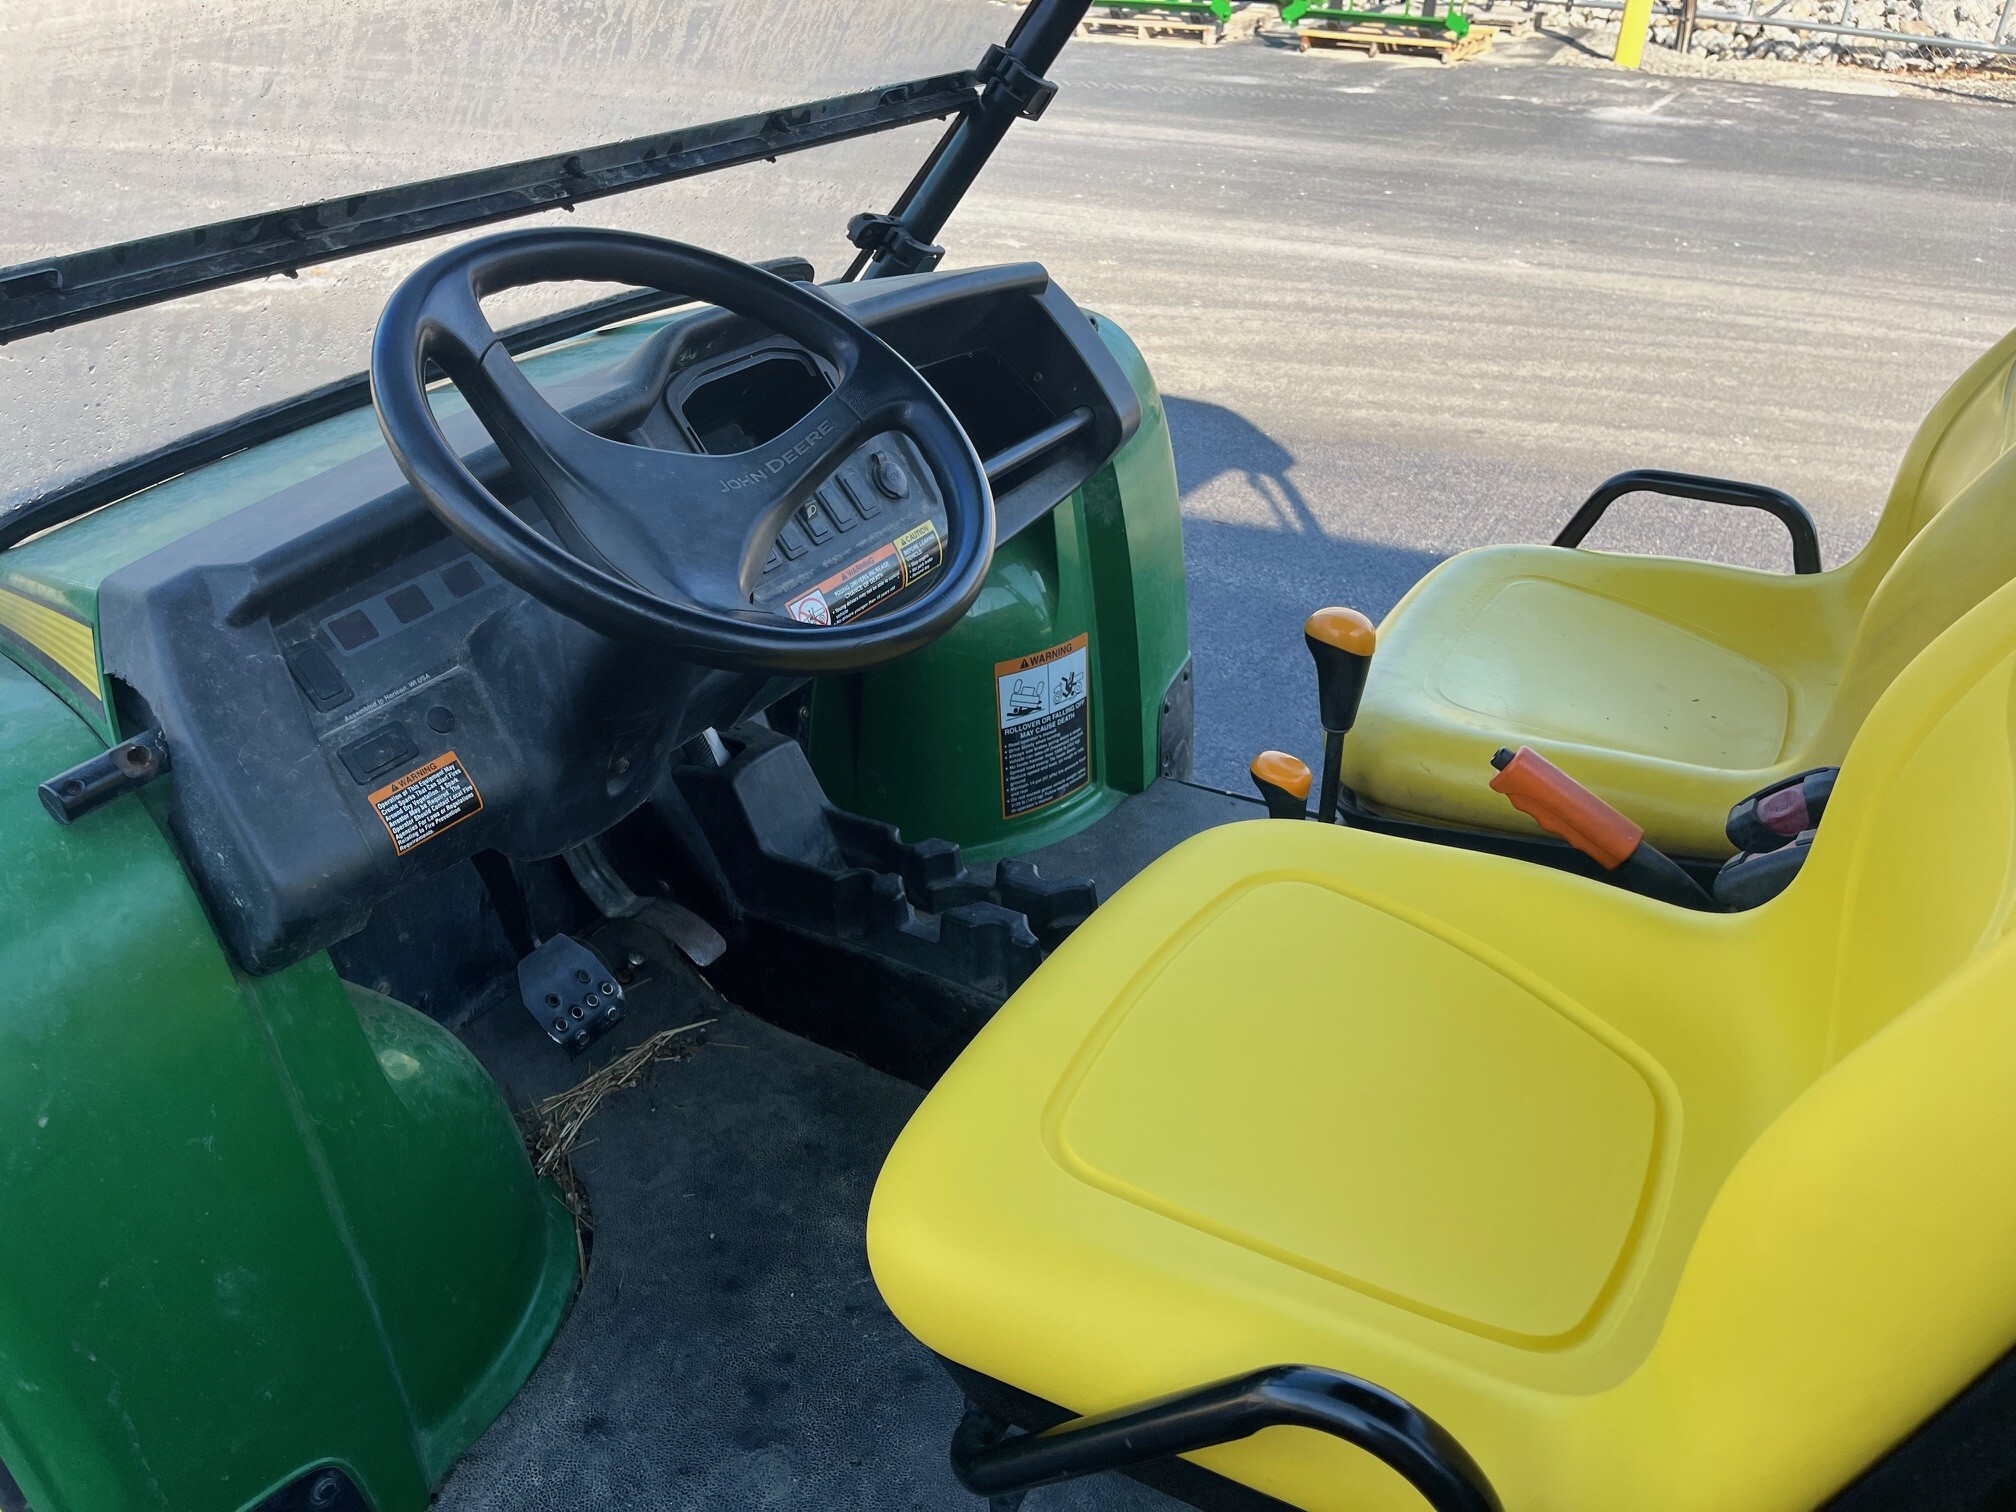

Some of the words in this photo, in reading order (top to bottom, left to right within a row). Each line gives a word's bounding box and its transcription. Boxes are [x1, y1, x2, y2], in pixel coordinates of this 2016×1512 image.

[719, 469, 766, 493] JOHN
[765, 420, 834, 474] DEERE
[903, 543, 919, 556] BEFORE
[919, 533, 935, 547] LEAVING
[905, 524, 929, 543] CAUTION
[834, 585, 850, 597] YOUNG
[850, 573, 869, 588] DRIVERS
[868, 561, 890, 577] INCREASE
[846, 557, 875, 577] WARNING
[844, 584, 863, 599] CHANCE
[862, 580, 869, 588] OF
[869, 572, 883, 584] DEATH
[834, 604, 847, 613] Young
[846, 596, 859, 606] drivers
[1030, 643, 1072, 666] WARNING
[344, 700, 377, 722] Assembled
[417, 673, 431, 684] USA
[1004, 719, 1041, 735] ROLLOVER
[1042, 716, 1051, 724] OR
[1052, 705, 1074, 720] FALLING
[1075, 699, 1085, 709] OFF
[1020, 729, 1034, 739] MAY
[1035, 721, 1056, 734] CAUSE
[1057, 712, 1075, 725] DEATH
[1009, 751, 1025, 759] Always
[398, 762, 437, 787] WARNING
[1010, 767, 1025, 775] Spread
[1010, 773, 1026, 781] Reduce
[377, 793, 403, 810] Operation
[407, 784, 419, 793] This
[418, 768, 445, 787] Equipment
[443, 764, 455, 773] May
[381, 804, 399, 815] Create
[397, 794, 416, 806] Sparks
[415, 787, 427, 797] That
[426, 782, 437, 790] Can
[436, 774, 449, 785] Start
[447, 769, 461, 778] Fires
[385, 808, 404, 822] Around
[402, 803, 413, 812] Dry
[444, 777, 459, 788] Spark
[1010, 783, 1029, 791] Maintain
[392, 818, 414, 834] Operator
[414, 808, 432, 821] Should
[431, 797, 450, 811] Contact
[449, 790, 463, 801] Local
[462, 785, 473, 794] Fire
[395, 824, 418, 840] Agencies
[418, 819, 427, 827] For
[426, 811, 440, 822] Laws
[445, 792, 474, 811] Regulations
[409, 807, 421, 816] May
[397, 831, 419, 846] Relating
[424, 822, 435, 830] Fire
[435, 807, 461, 824] Prevention
